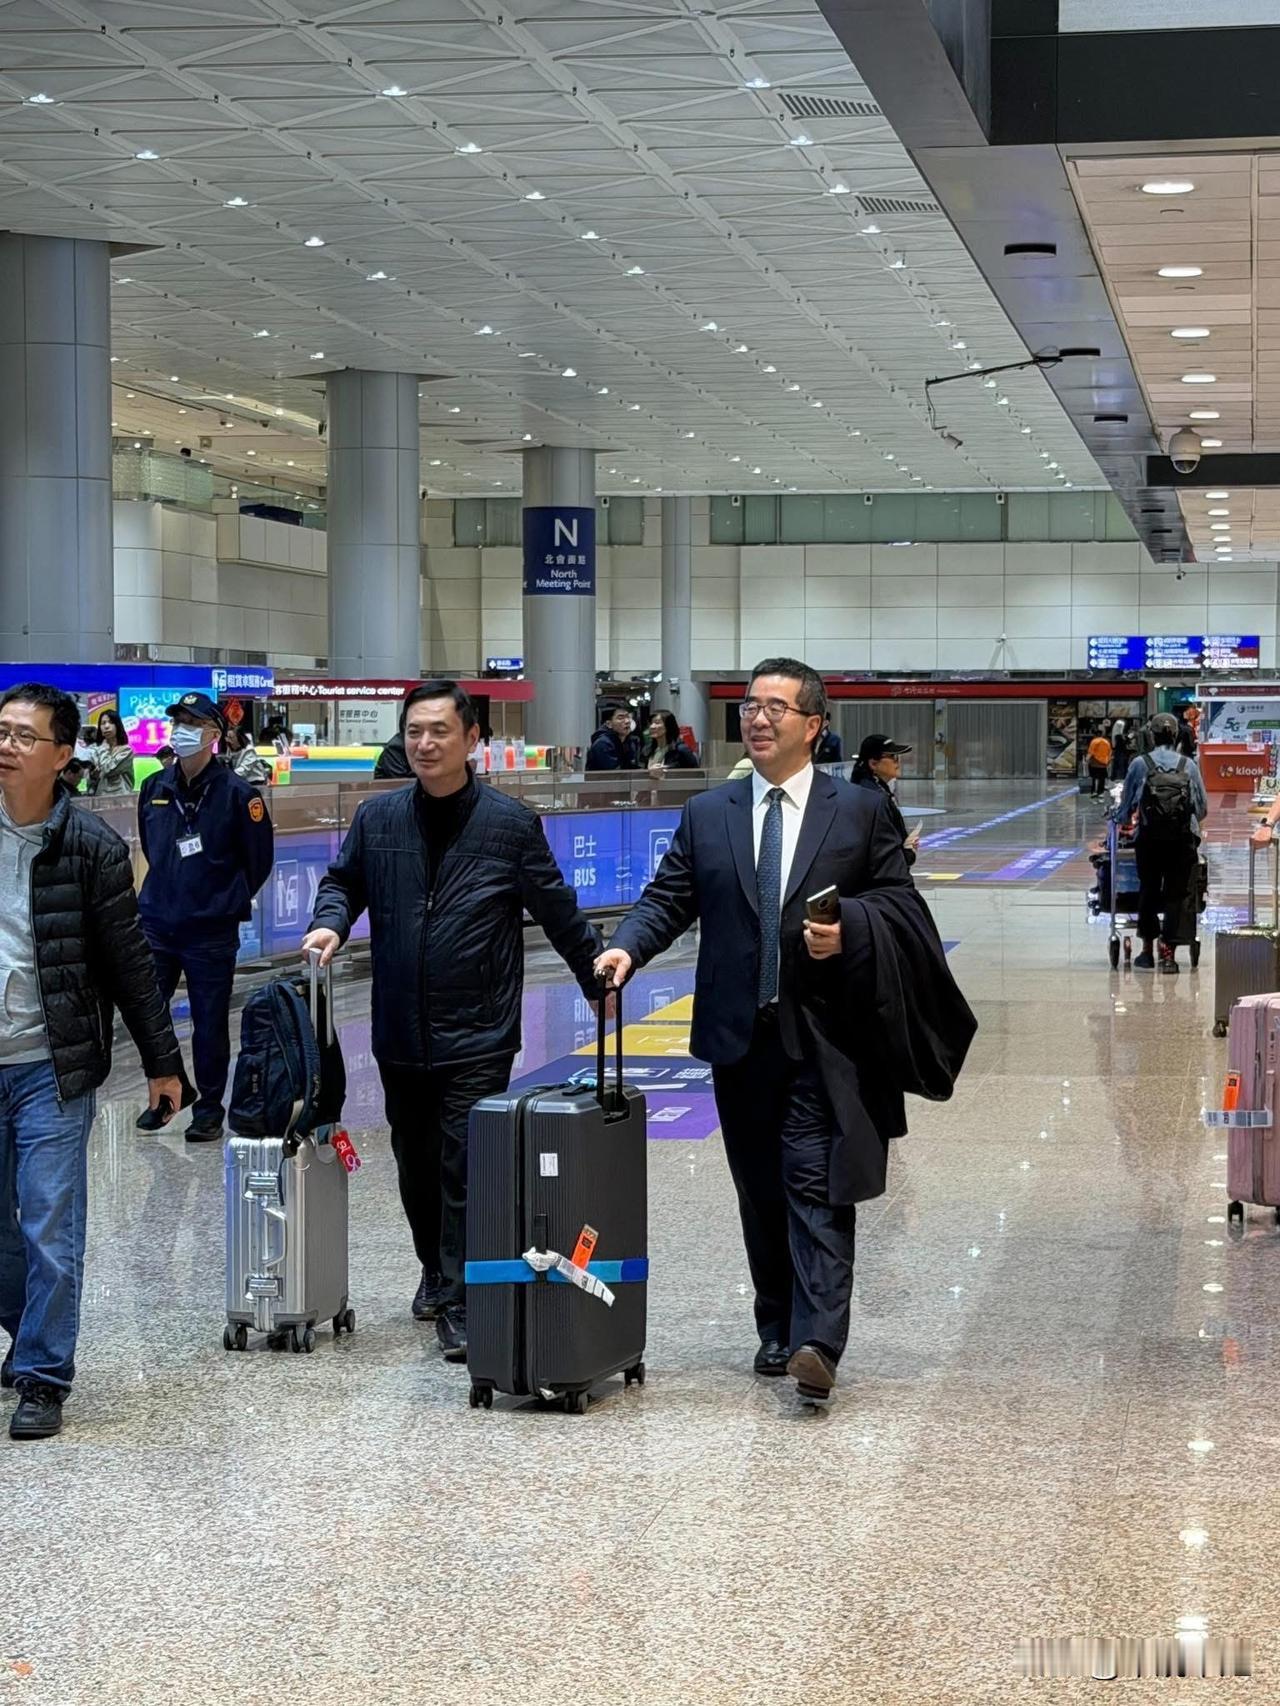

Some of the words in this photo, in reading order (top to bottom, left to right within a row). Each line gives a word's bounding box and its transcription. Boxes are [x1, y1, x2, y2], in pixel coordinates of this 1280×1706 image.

[554, 518, 578, 547] N
[544, 554, 586, 565] 北會面點
[550, 569, 577, 578] North
[535, 579, 572, 591] Meeting
[573, 579, 591, 588] Point
[272, 685, 318, 696] 客服務中心
[318, 685, 345, 695] Tourist
[346, 687, 376, 695] service
[377, 686, 405, 696] center
[1235, 765, 1264, 776] klook
[574, 835, 597, 858] 巴士
[573, 868, 597, 887] BUS
